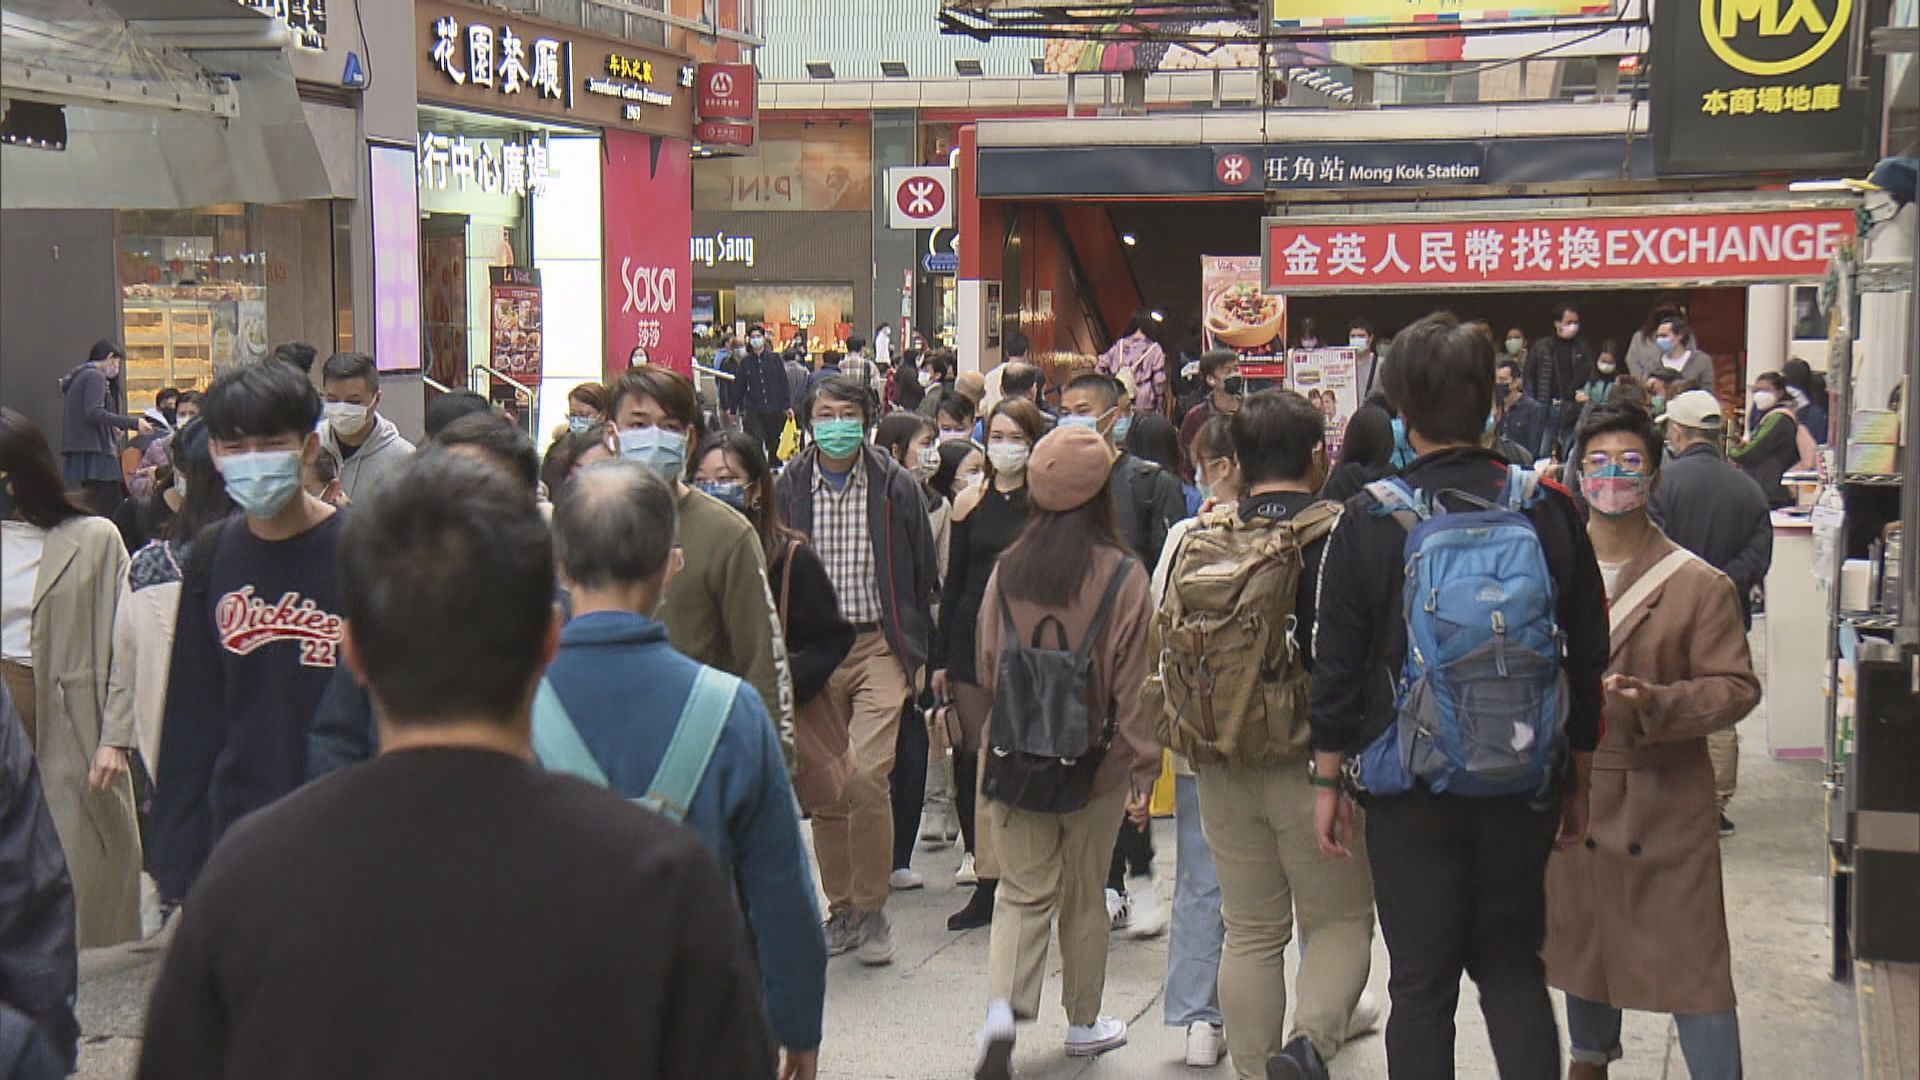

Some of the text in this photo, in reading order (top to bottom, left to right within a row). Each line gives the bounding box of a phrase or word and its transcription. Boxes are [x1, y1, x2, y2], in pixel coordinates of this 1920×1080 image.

[433, 16, 561, 99] 花園餐廳
[1702, 84, 1841, 115] 本商場地庫
[416, 131, 548, 197] 行中心廣場
[1264, 156, 1479, 183] 旺角站 Mong Kok Station
[717, 232, 753, 267] Sang
[1606, 222, 1841, 265] EXCHANGE
[621, 256, 676, 314] Sasa
[638, 320, 660, 347] 莎莎
[215, 585, 343, 638] Dickies
[300, 639, 336, 667] 22
